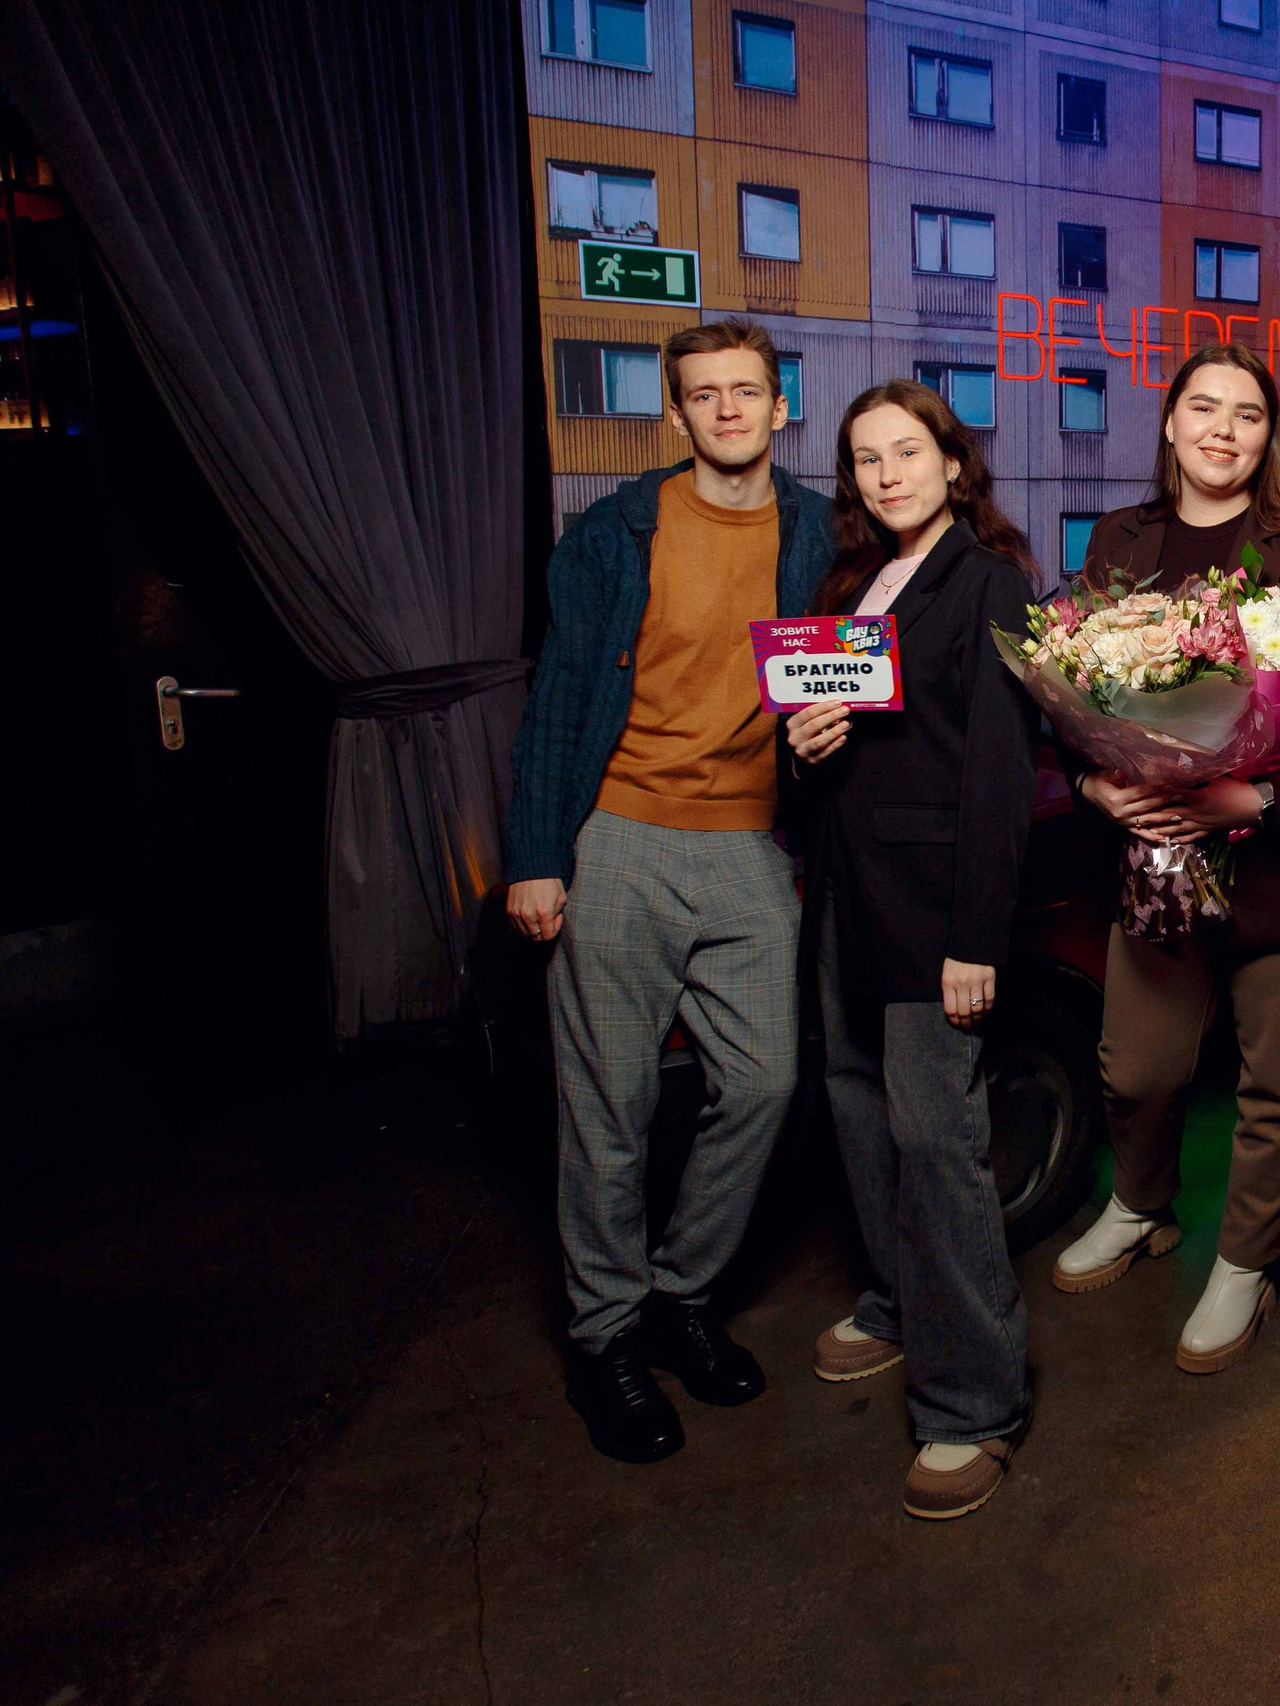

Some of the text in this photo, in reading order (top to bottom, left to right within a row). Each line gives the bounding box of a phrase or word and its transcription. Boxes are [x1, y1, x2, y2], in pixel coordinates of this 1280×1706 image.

[770, 625, 820, 637] ЗОВИТЕ
[845, 625, 869, 642] ВАУ
[782, 637, 811, 648] НАС:
[853, 635, 880, 652] КВИЗ
[784, 662, 873, 677] БРАГИНО
[802, 680, 860, 695] ЗДЕСЬ
